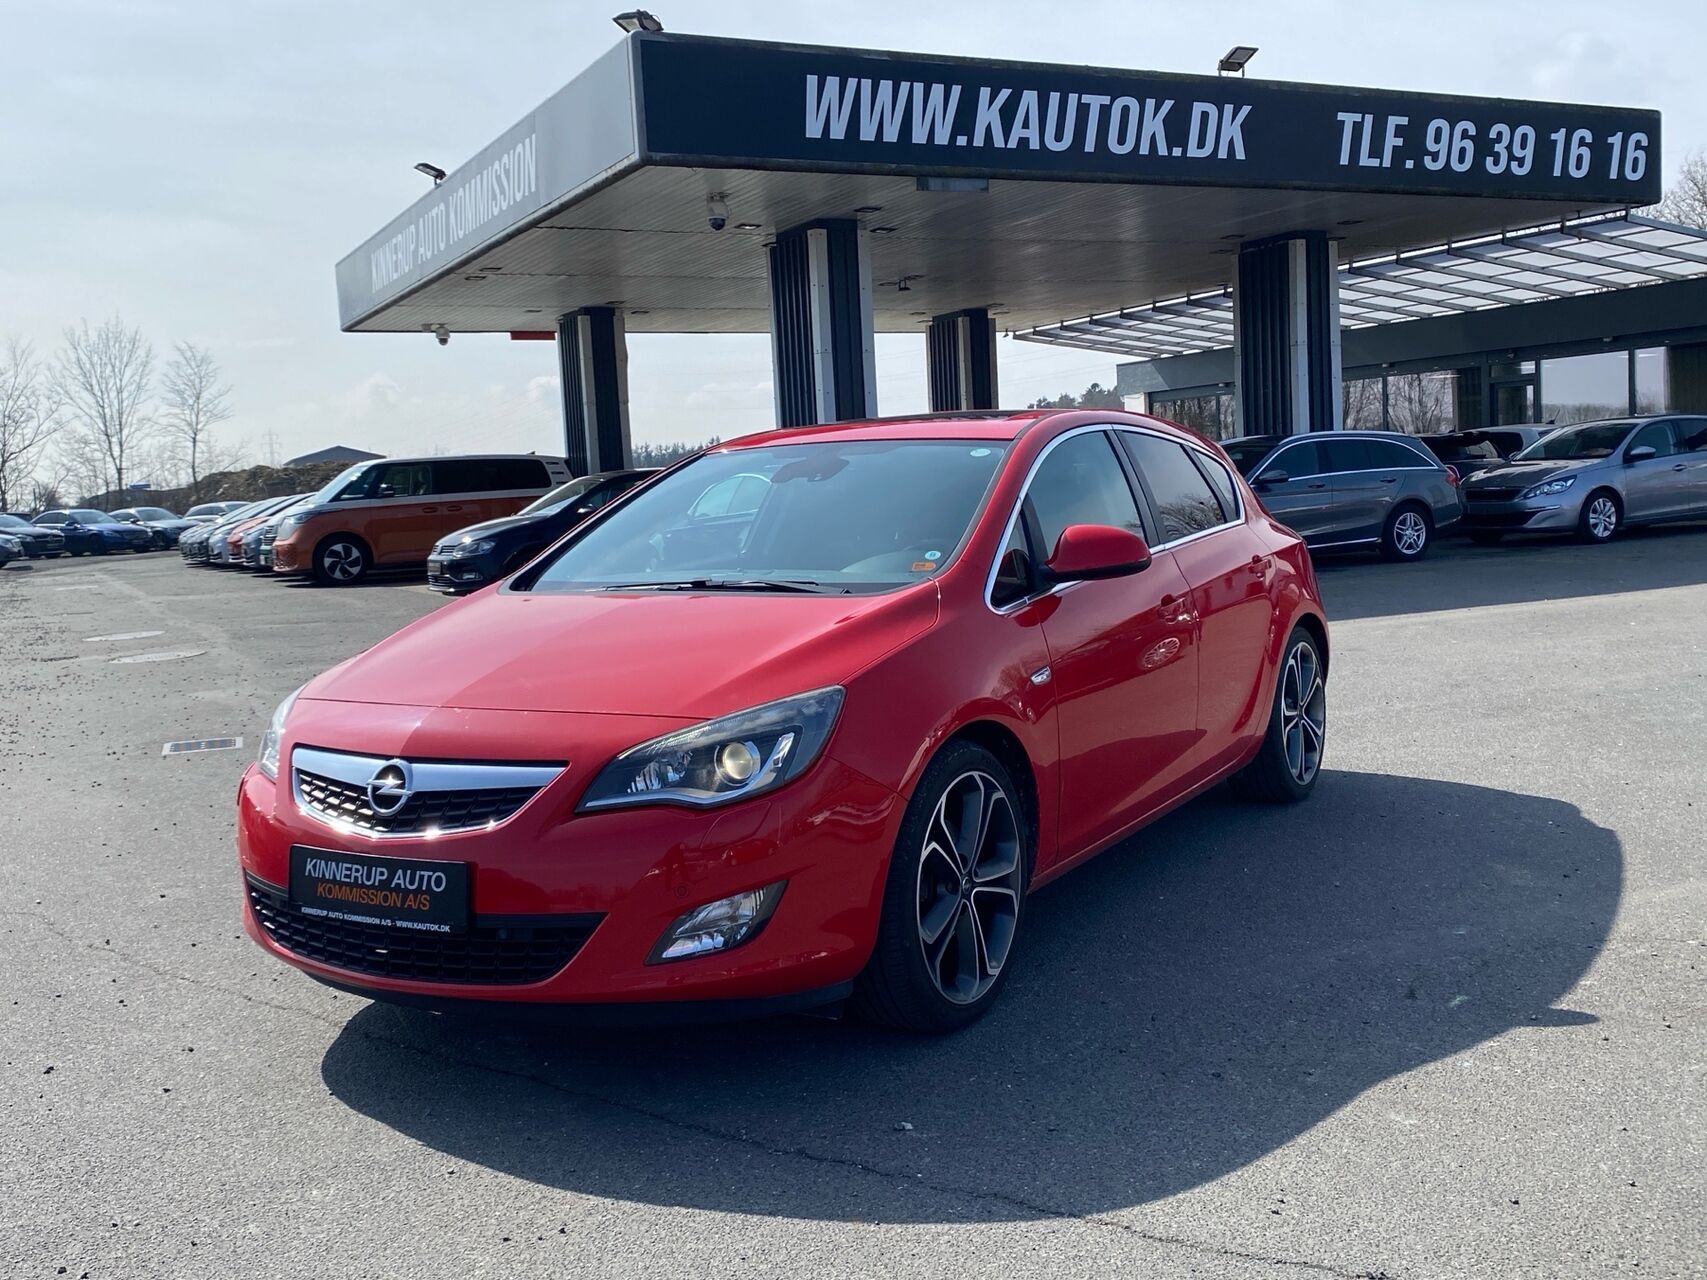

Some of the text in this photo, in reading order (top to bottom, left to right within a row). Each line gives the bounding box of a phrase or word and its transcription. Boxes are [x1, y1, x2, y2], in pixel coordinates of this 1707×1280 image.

[805, 74, 1252, 160] WWW.KAUTOK.DK
[1337, 111, 1649, 182] TLF. 96 39 16 16
[370, 133, 537, 294] KINNERUP AUTO KOMMISSION
[305, 857, 446, 892] KINNERUP AUTO
[317, 882, 431, 910] KOMMISSION A/S
[301, 906, 328, 917] KINNERUP
[328, 911, 344, 920] AUTO
[344, 913, 381, 925] KOMMISSION
[396, 920, 451, 933] WWW.KAUTOK.DK
